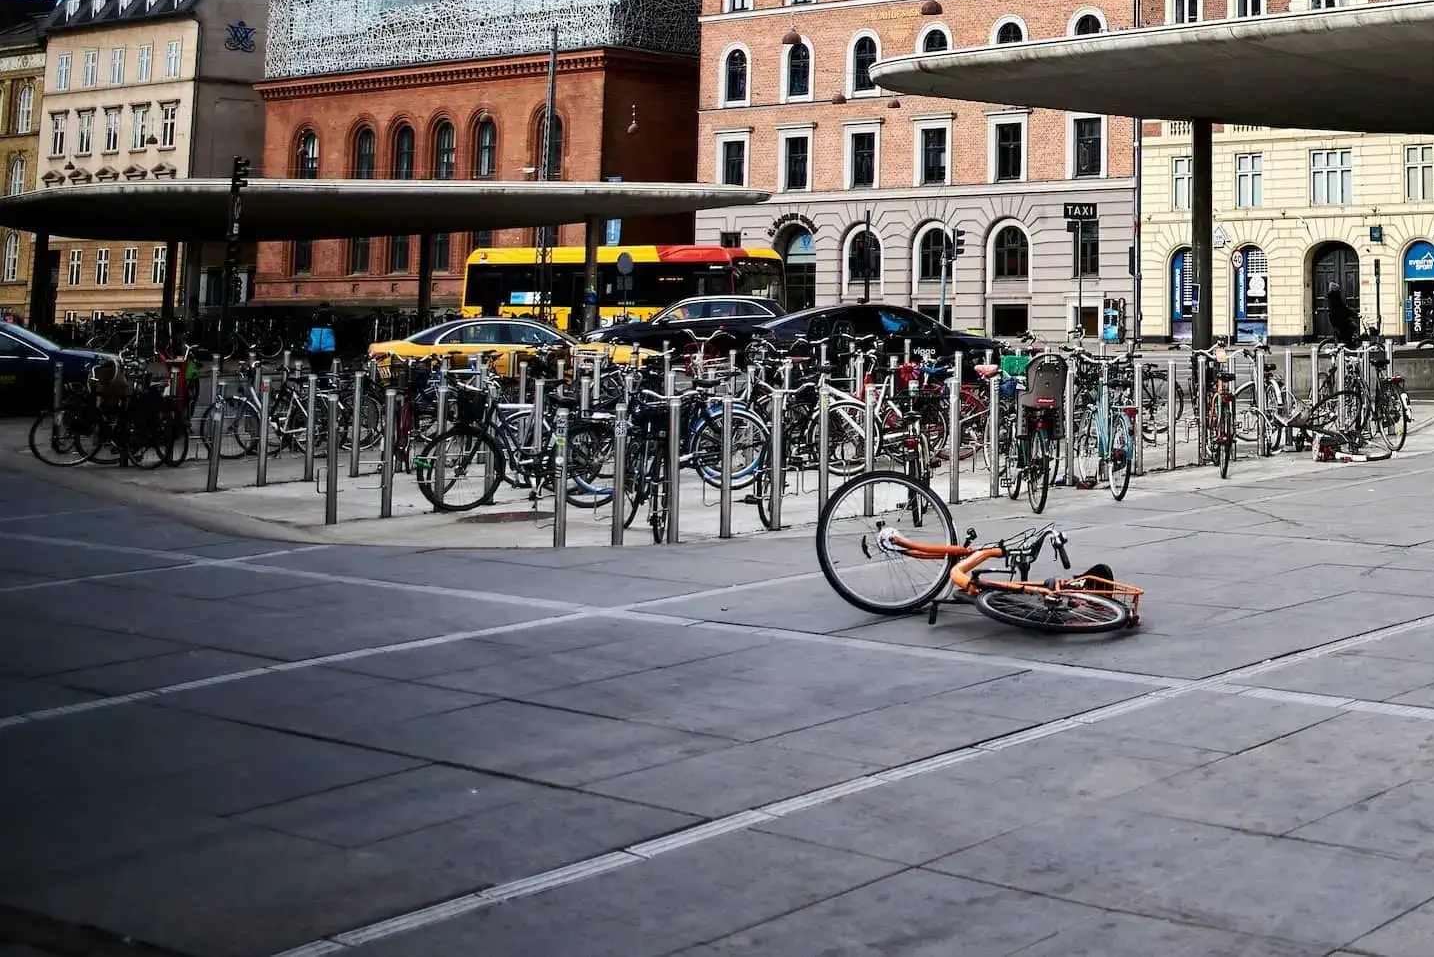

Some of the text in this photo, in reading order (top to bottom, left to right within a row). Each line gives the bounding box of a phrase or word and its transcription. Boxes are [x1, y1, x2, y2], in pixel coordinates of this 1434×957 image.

[1066, 205, 1093, 216] TAXI
[1233, 255, 1242, 263] 40
[1413, 291, 1422, 332] INDGANG
